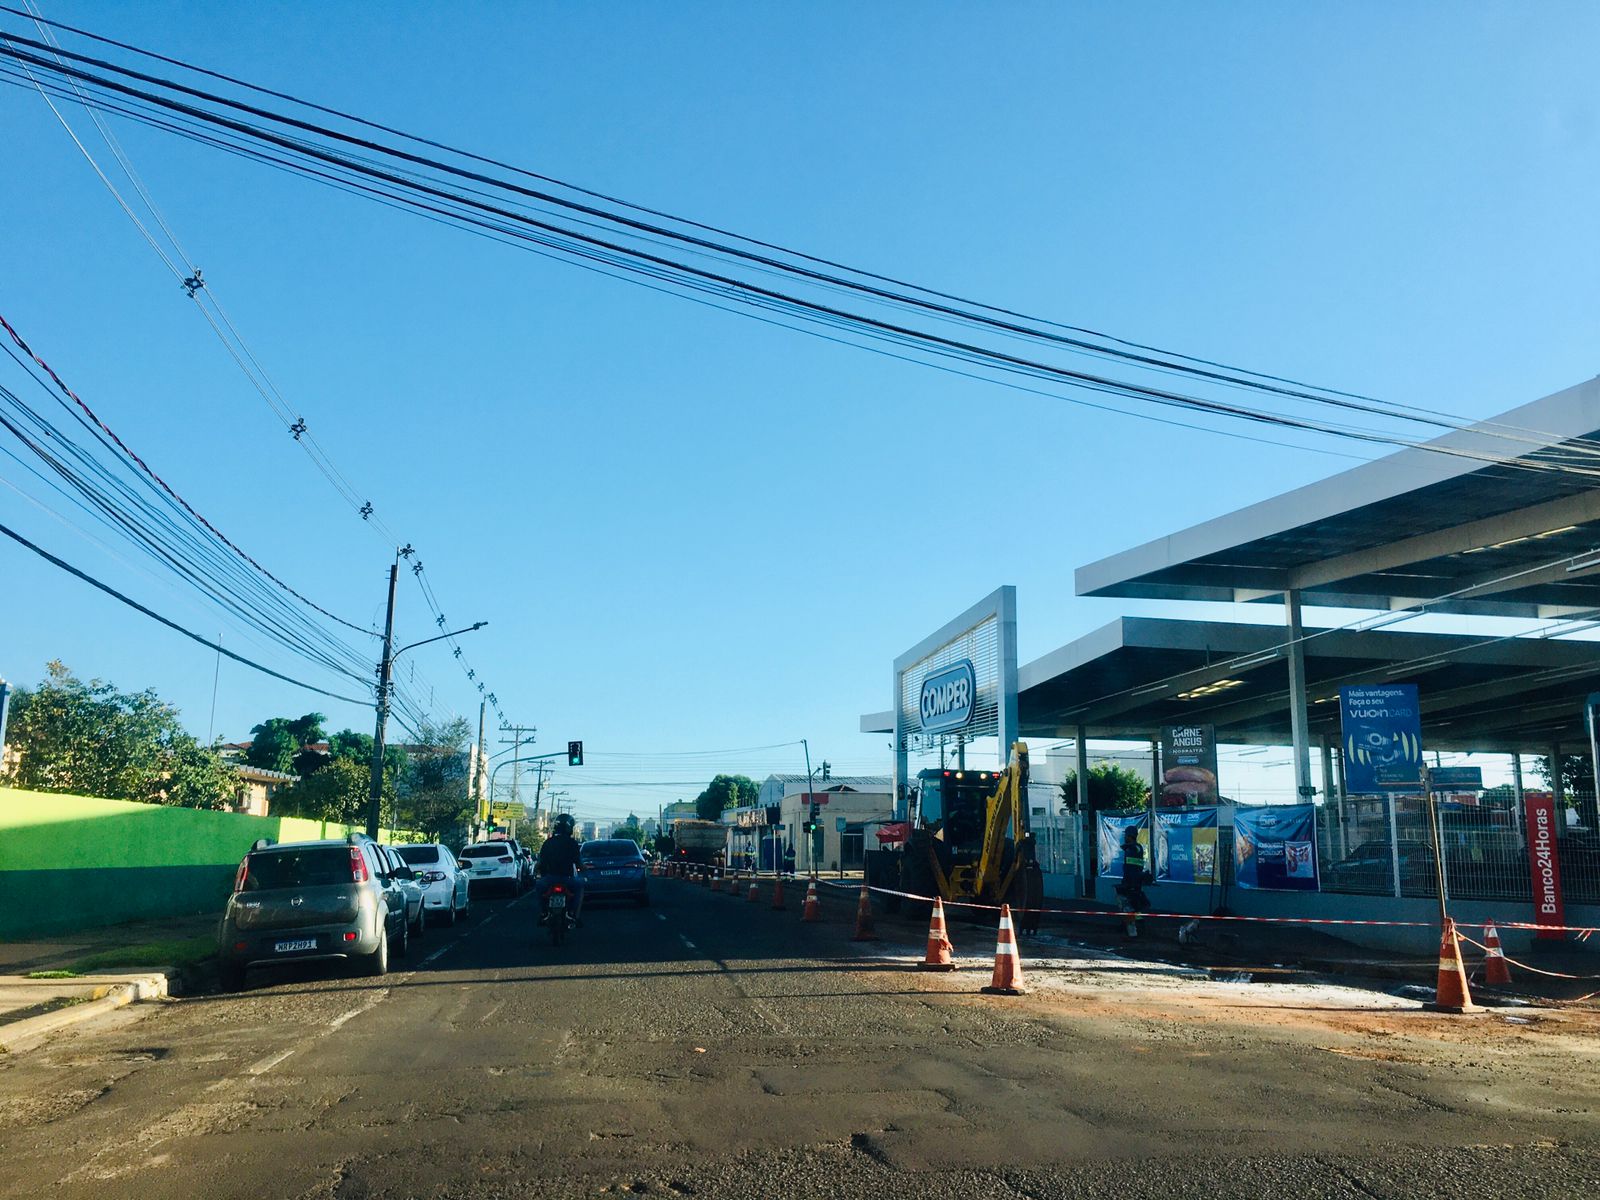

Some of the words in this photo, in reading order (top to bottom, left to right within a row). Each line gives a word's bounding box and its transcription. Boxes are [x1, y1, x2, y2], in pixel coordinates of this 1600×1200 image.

[922, 678, 968, 718] COMPER
[1348, 689, 1365, 697] Mais
[1365, 689, 1404, 698] vantagens.
[1348, 699, 1365, 708] Faça
[1172, 728, 1202, 738] CARNE
[1173, 737, 1202, 747] ANGUS
[1160, 813, 1182, 825] OFERTA
[1535, 808, 1556, 914] Banco24Horas
